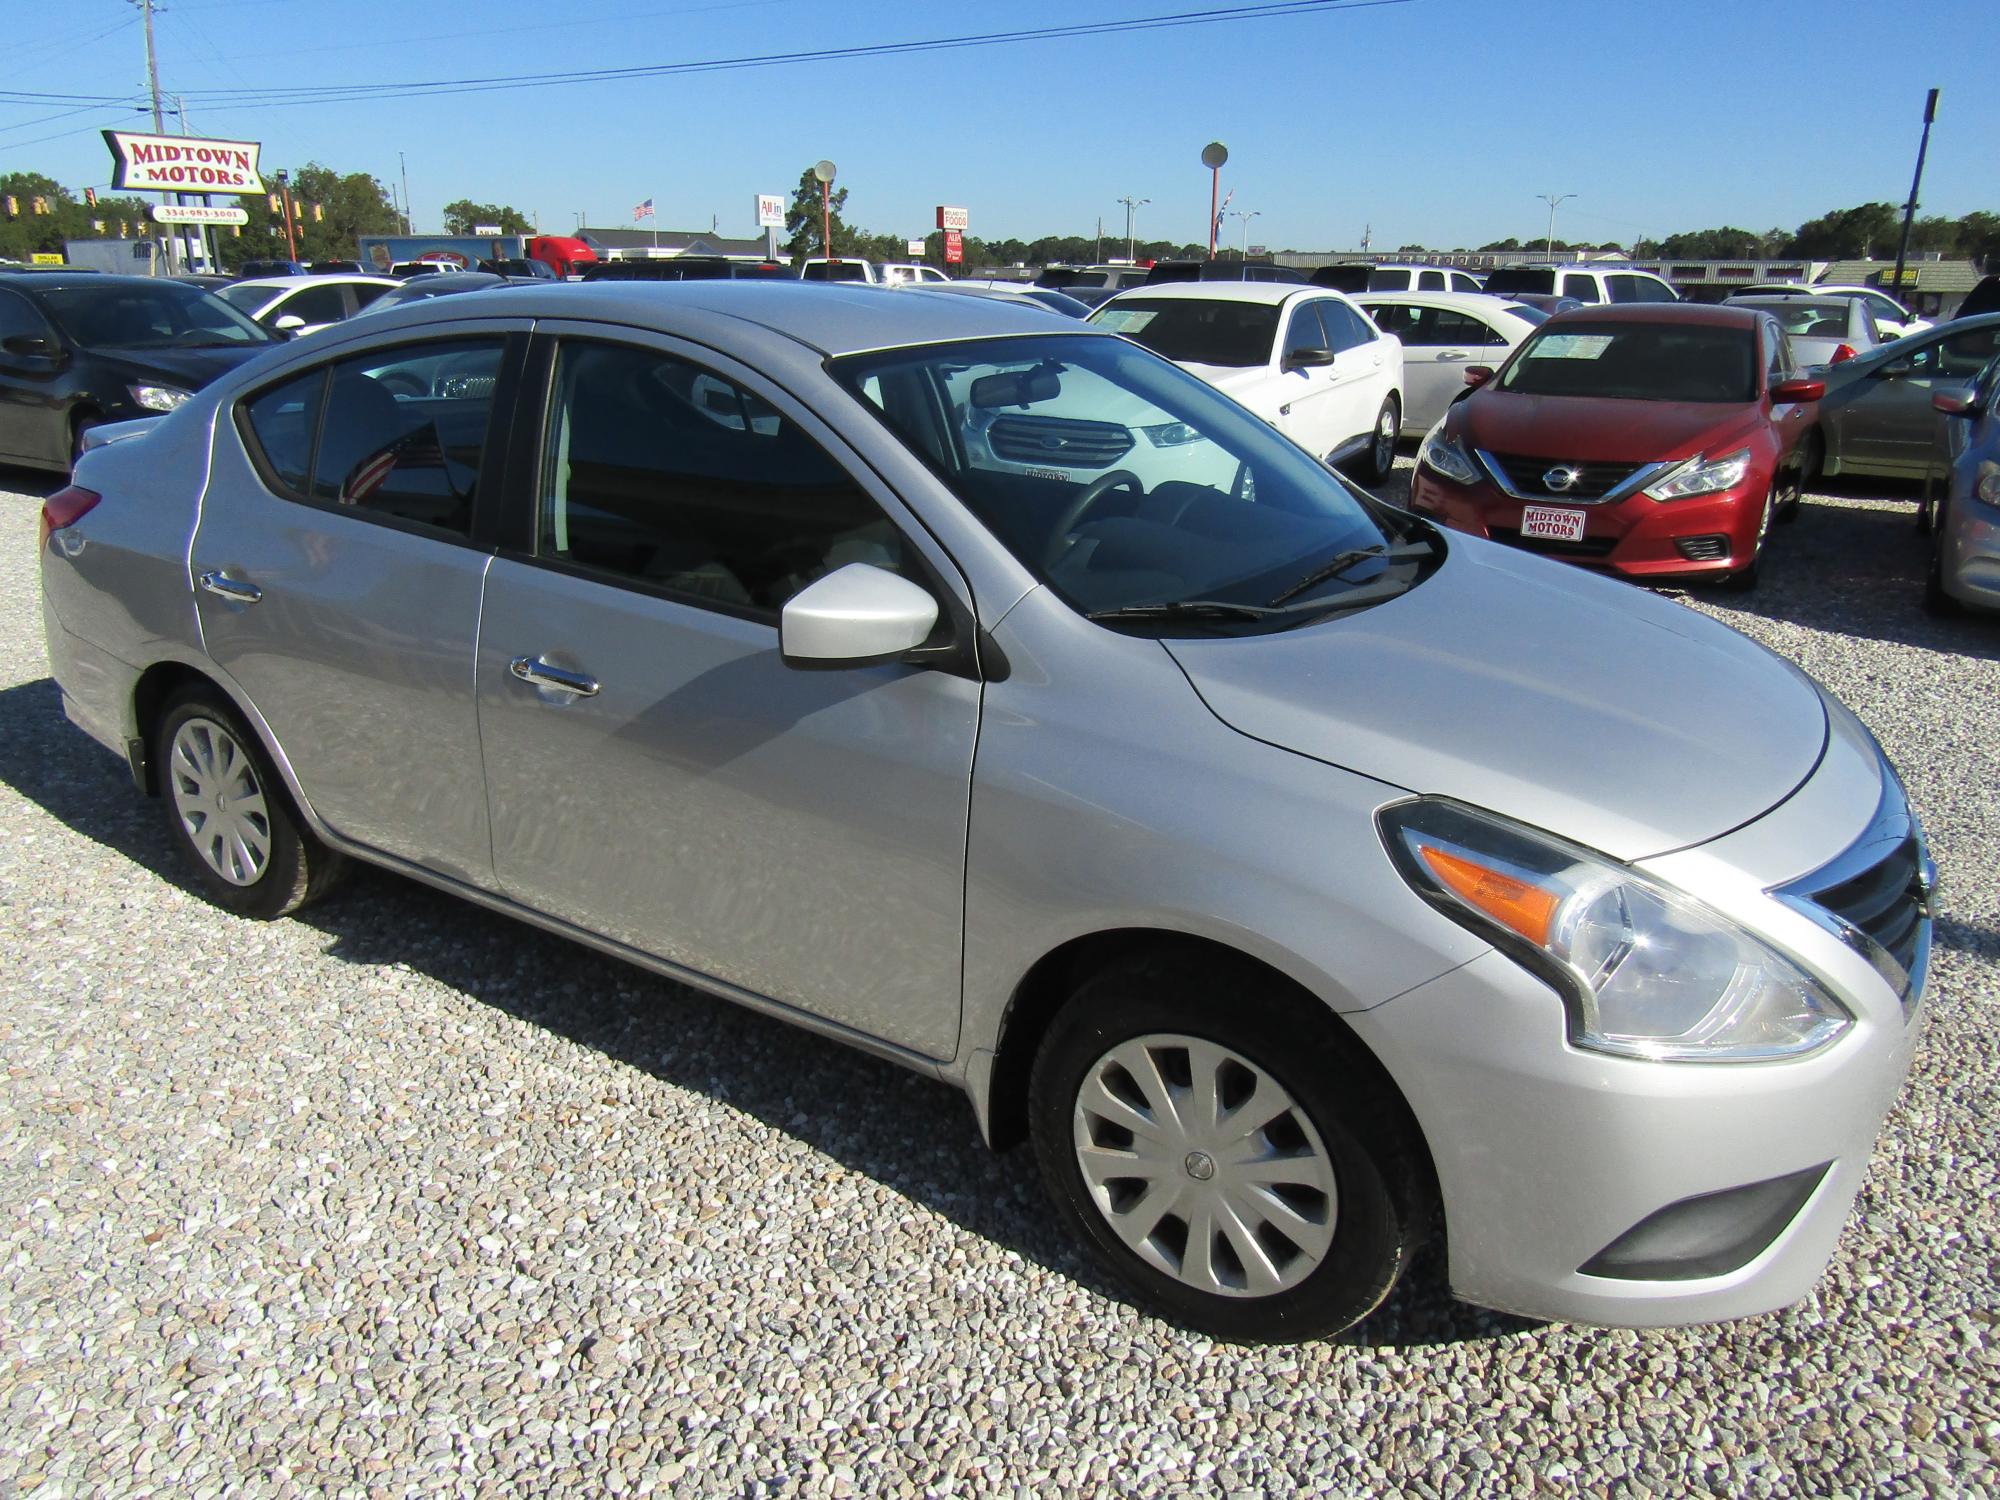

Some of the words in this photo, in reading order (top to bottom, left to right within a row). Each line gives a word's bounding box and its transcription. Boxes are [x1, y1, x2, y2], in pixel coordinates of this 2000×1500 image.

[130, 143, 251, 172] MIDTOWN
[147, 166, 245, 186] MOTORS
[761, 200, 773, 216] All
[774, 202, 782, 215] in
[945, 216, 967, 226] FOODS
[1526, 511, 1580, 528] MIDTOWN
[1528, 523, 1575, 536] MOTORS
